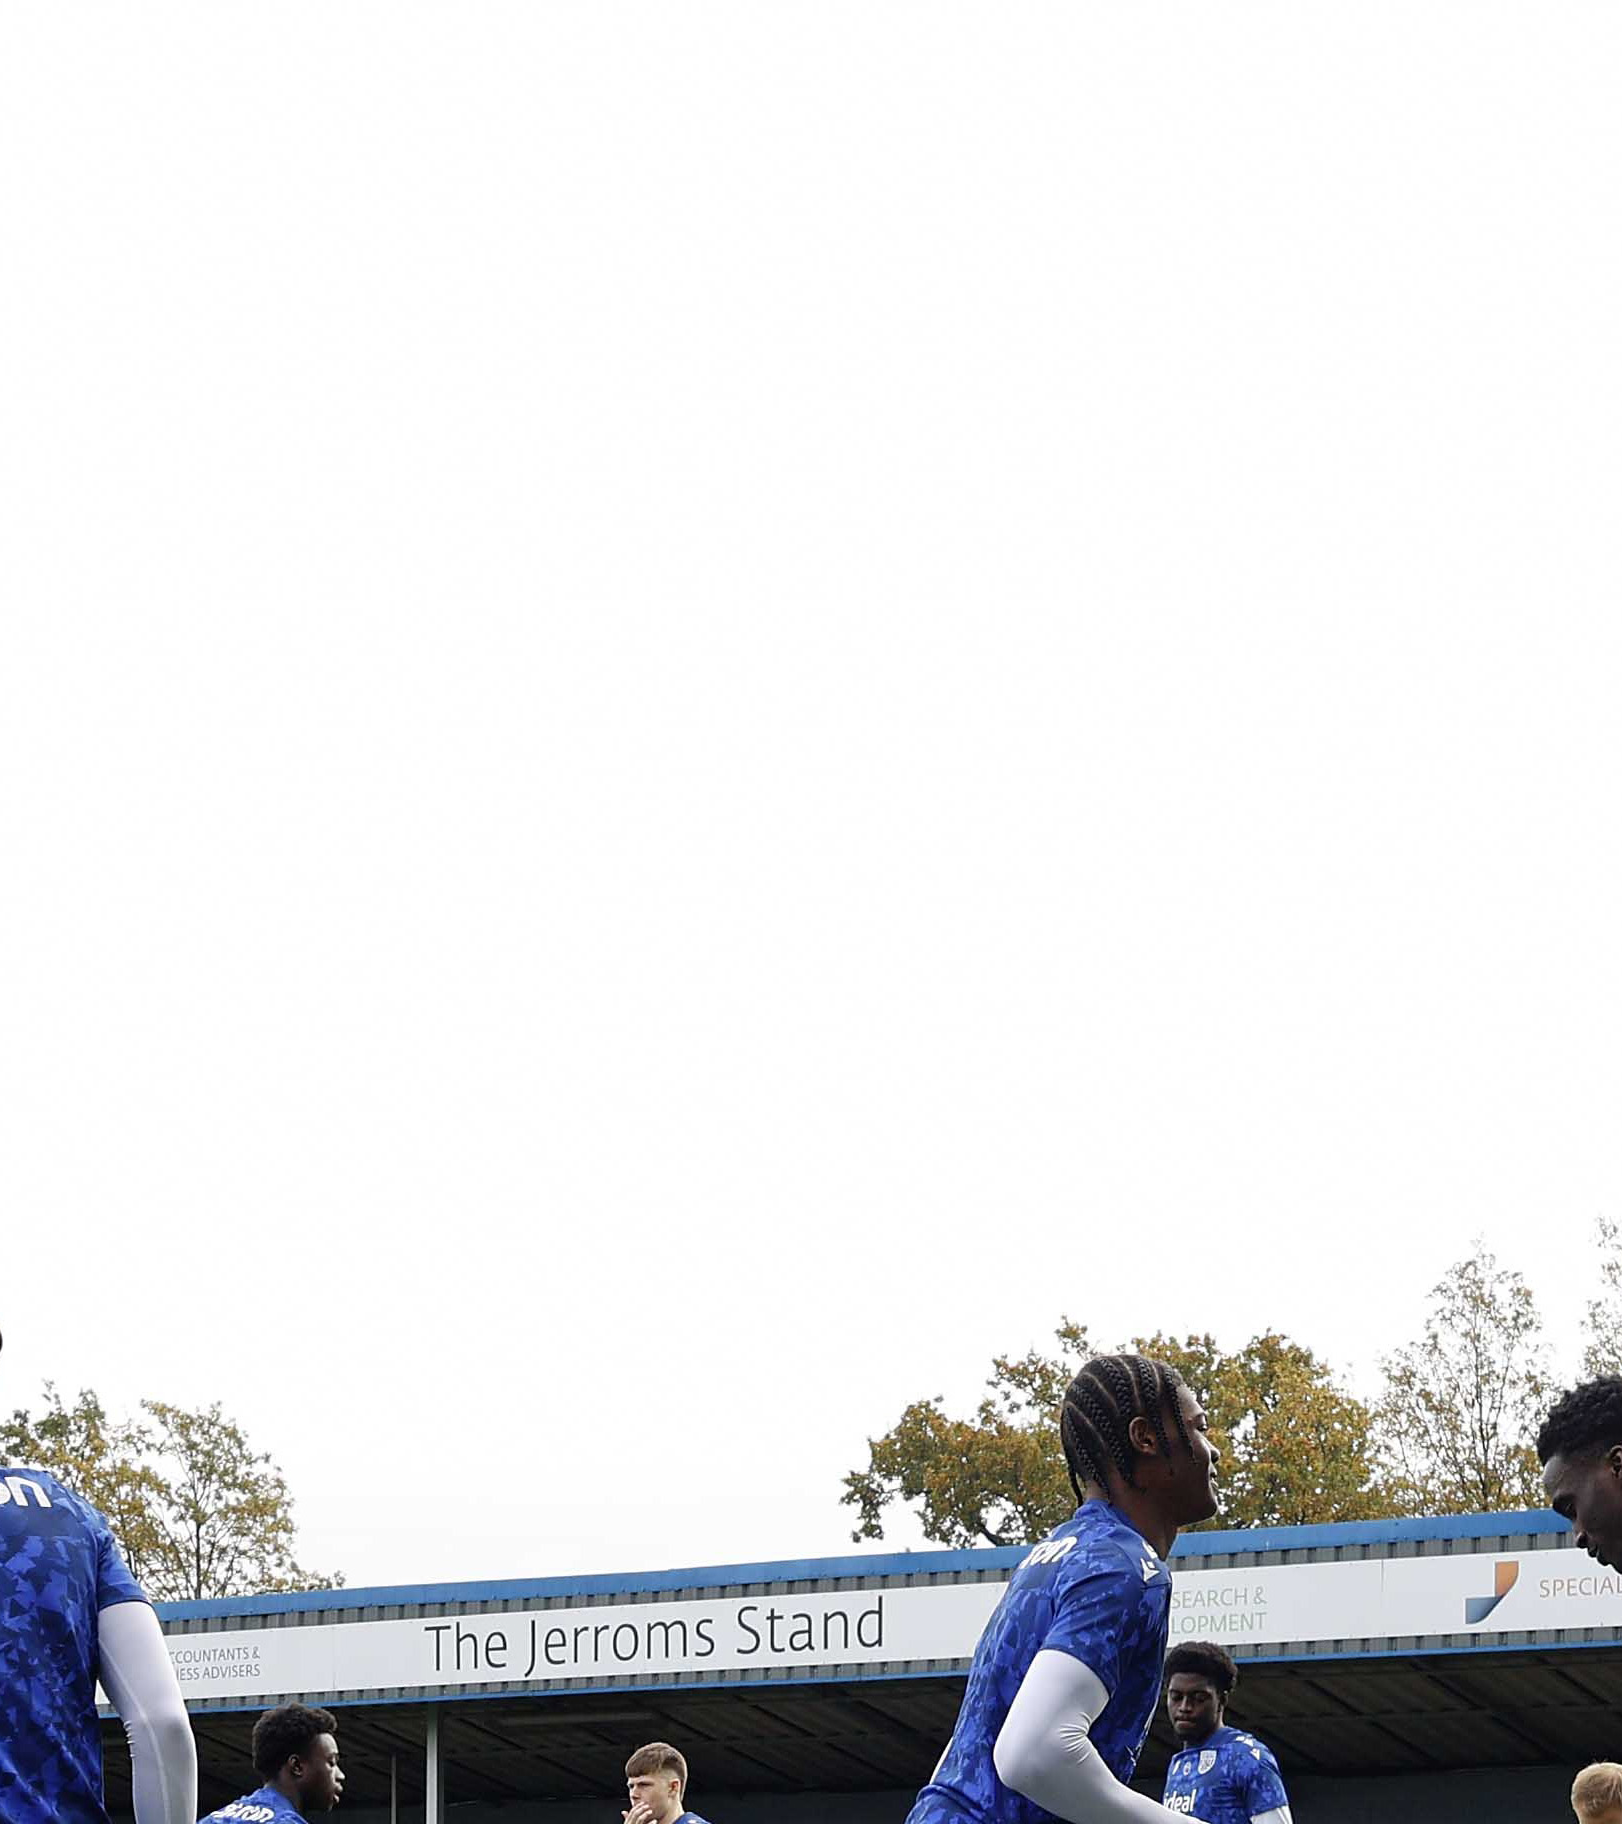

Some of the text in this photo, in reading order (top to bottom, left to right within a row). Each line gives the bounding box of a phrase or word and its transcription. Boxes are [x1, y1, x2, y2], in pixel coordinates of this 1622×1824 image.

[1171, 1586, 1267, 1609] SEARCH &
[424, 1595, 884, 1678] The Jerroms Stand
[252, 1646, 261, 1660] &
[202, 1664, 261, 1680] ADVISERS
